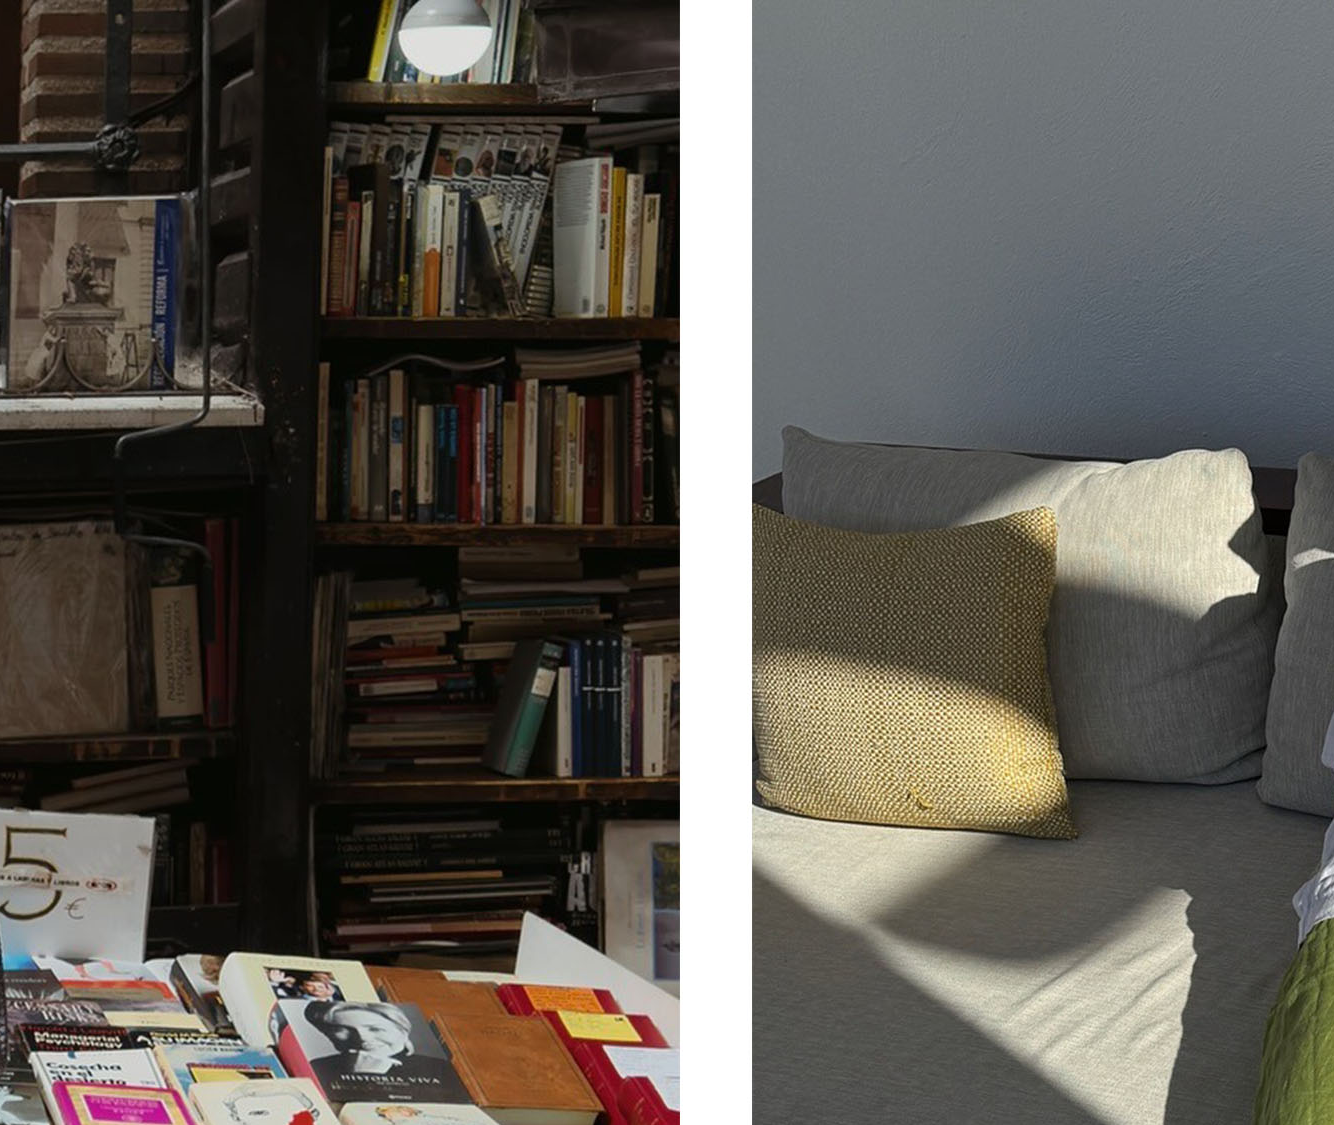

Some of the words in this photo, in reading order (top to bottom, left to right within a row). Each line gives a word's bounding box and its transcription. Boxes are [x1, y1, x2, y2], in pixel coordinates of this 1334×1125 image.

[33, 1031, 121, 1043] Managerial
[35, 1037, 123, 1050] Psychology
[46, 1061, 122, 1071] Cosecha
[48, 1069, 73, 1077] en
[77, 1069, 93, 1077] el
[340, 1073, 405, 1083] HISTORIA
[408, 1076, 441, 1084] VIVA
